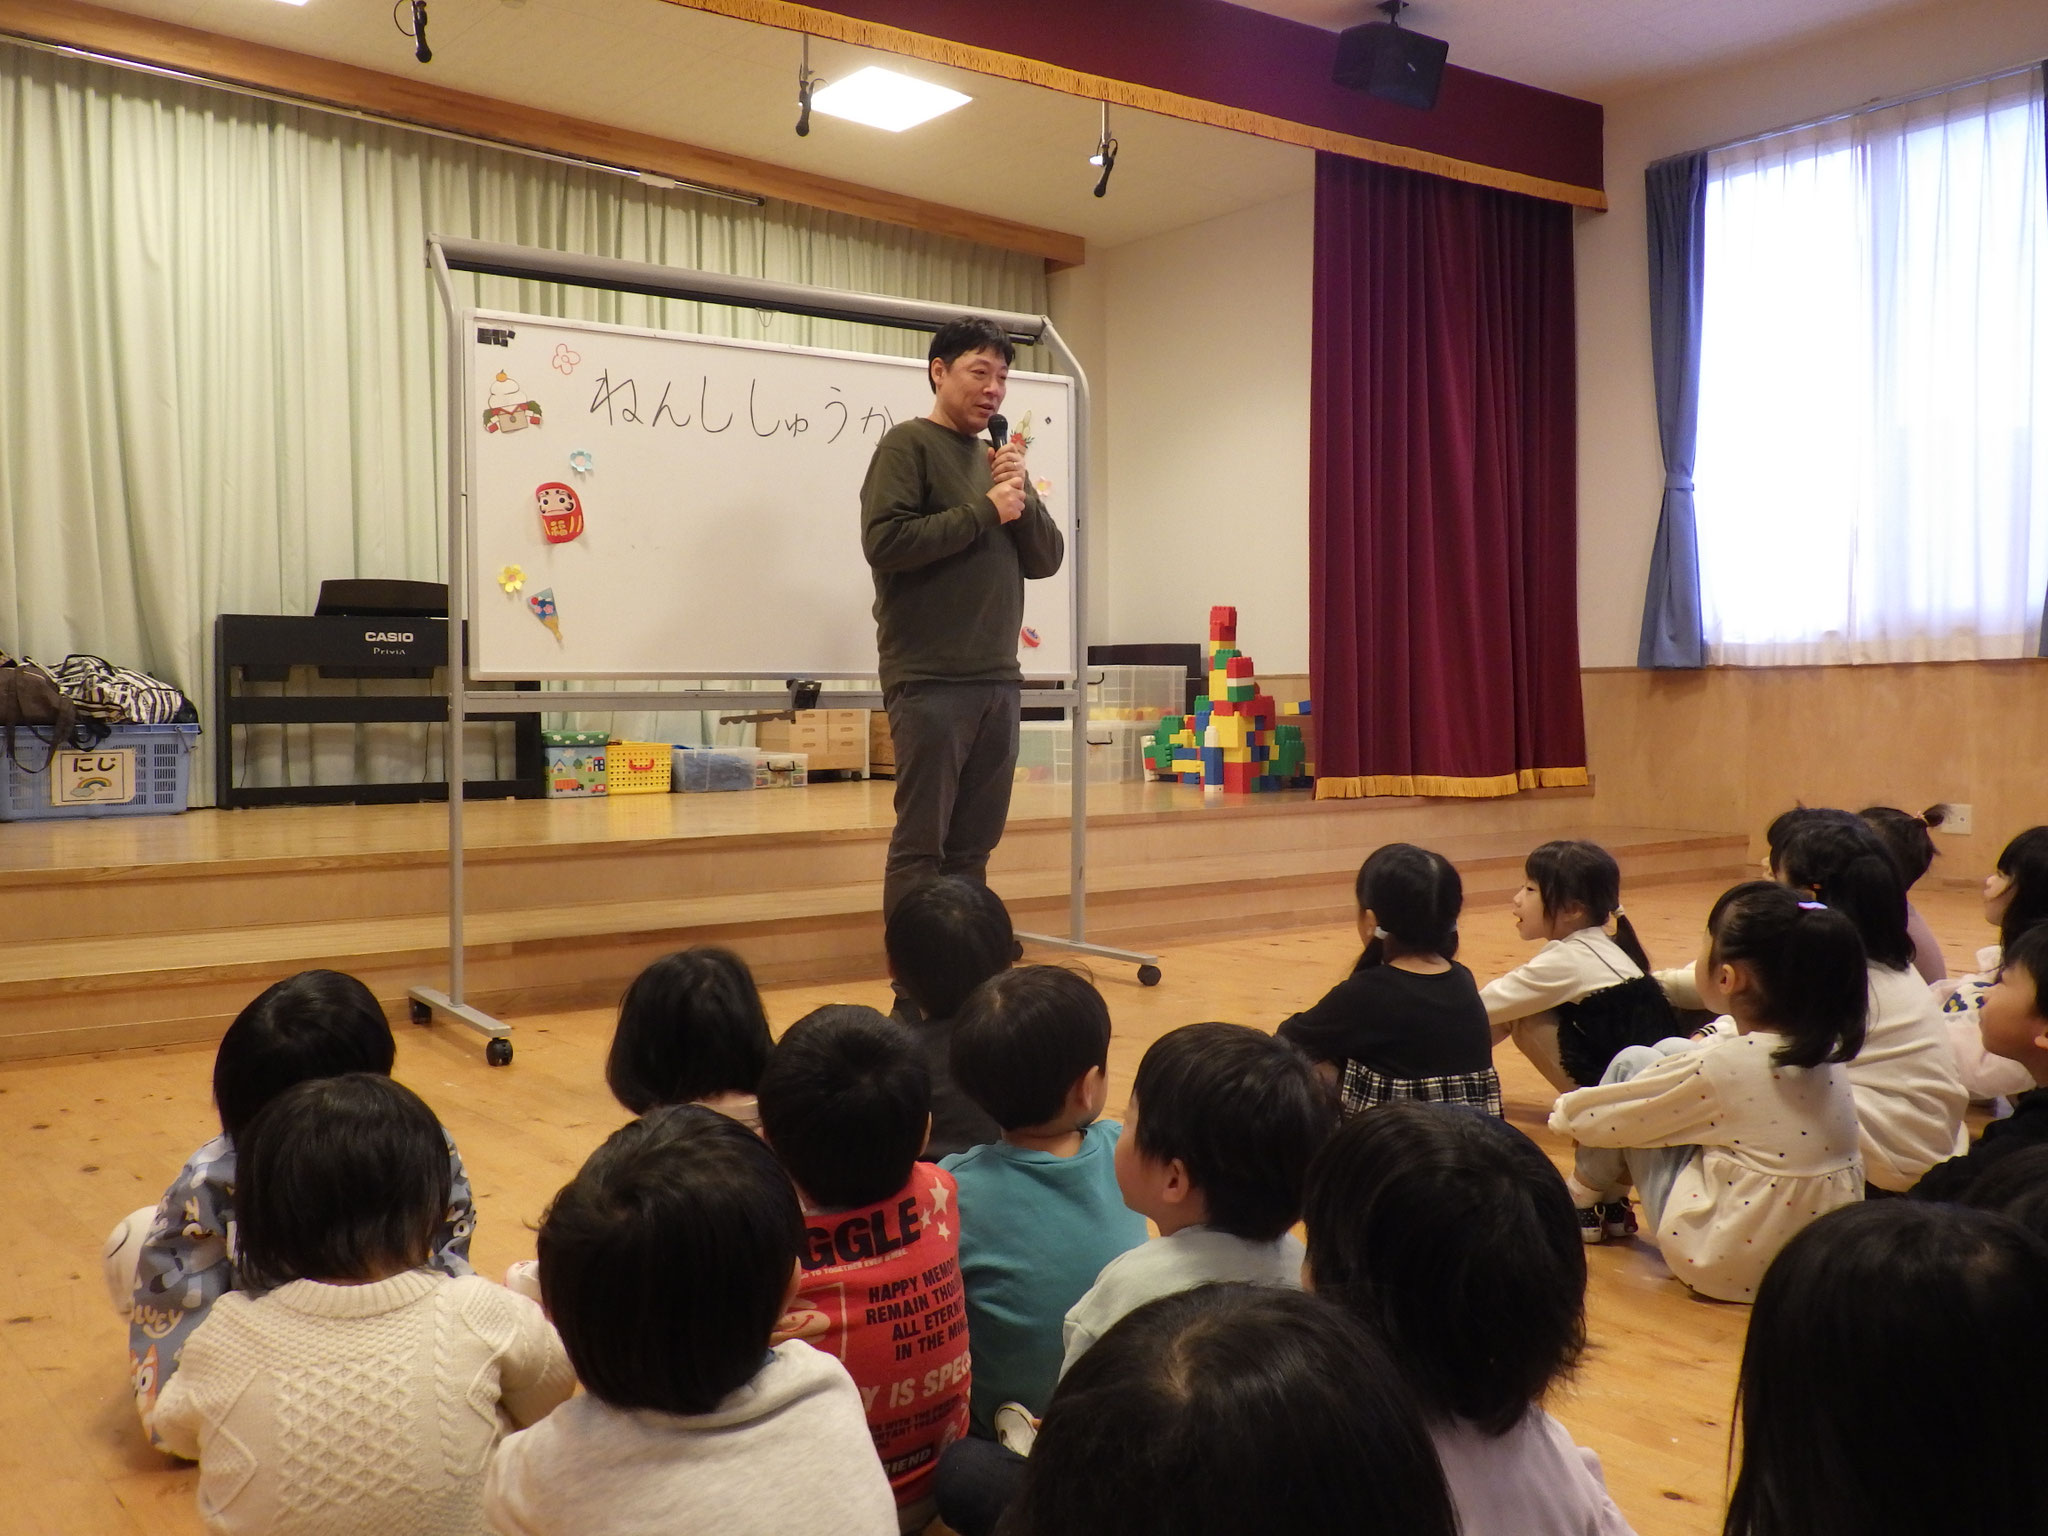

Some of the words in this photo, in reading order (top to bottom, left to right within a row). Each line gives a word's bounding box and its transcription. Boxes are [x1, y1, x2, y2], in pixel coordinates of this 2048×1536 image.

[365, 631, 414, 643] CASIO
[73, 757, 117, 772] にじ
[868, 1275, 917, 1304] HAPPY
[865, 1294, 930, 1326] REMAIN
[892, 1320, 920, 1342] ALL
[895, 1343, 912, 1361] IN
[917, 1330, 944, 1355] THE
[889, 1378, 915, 1410] IS
